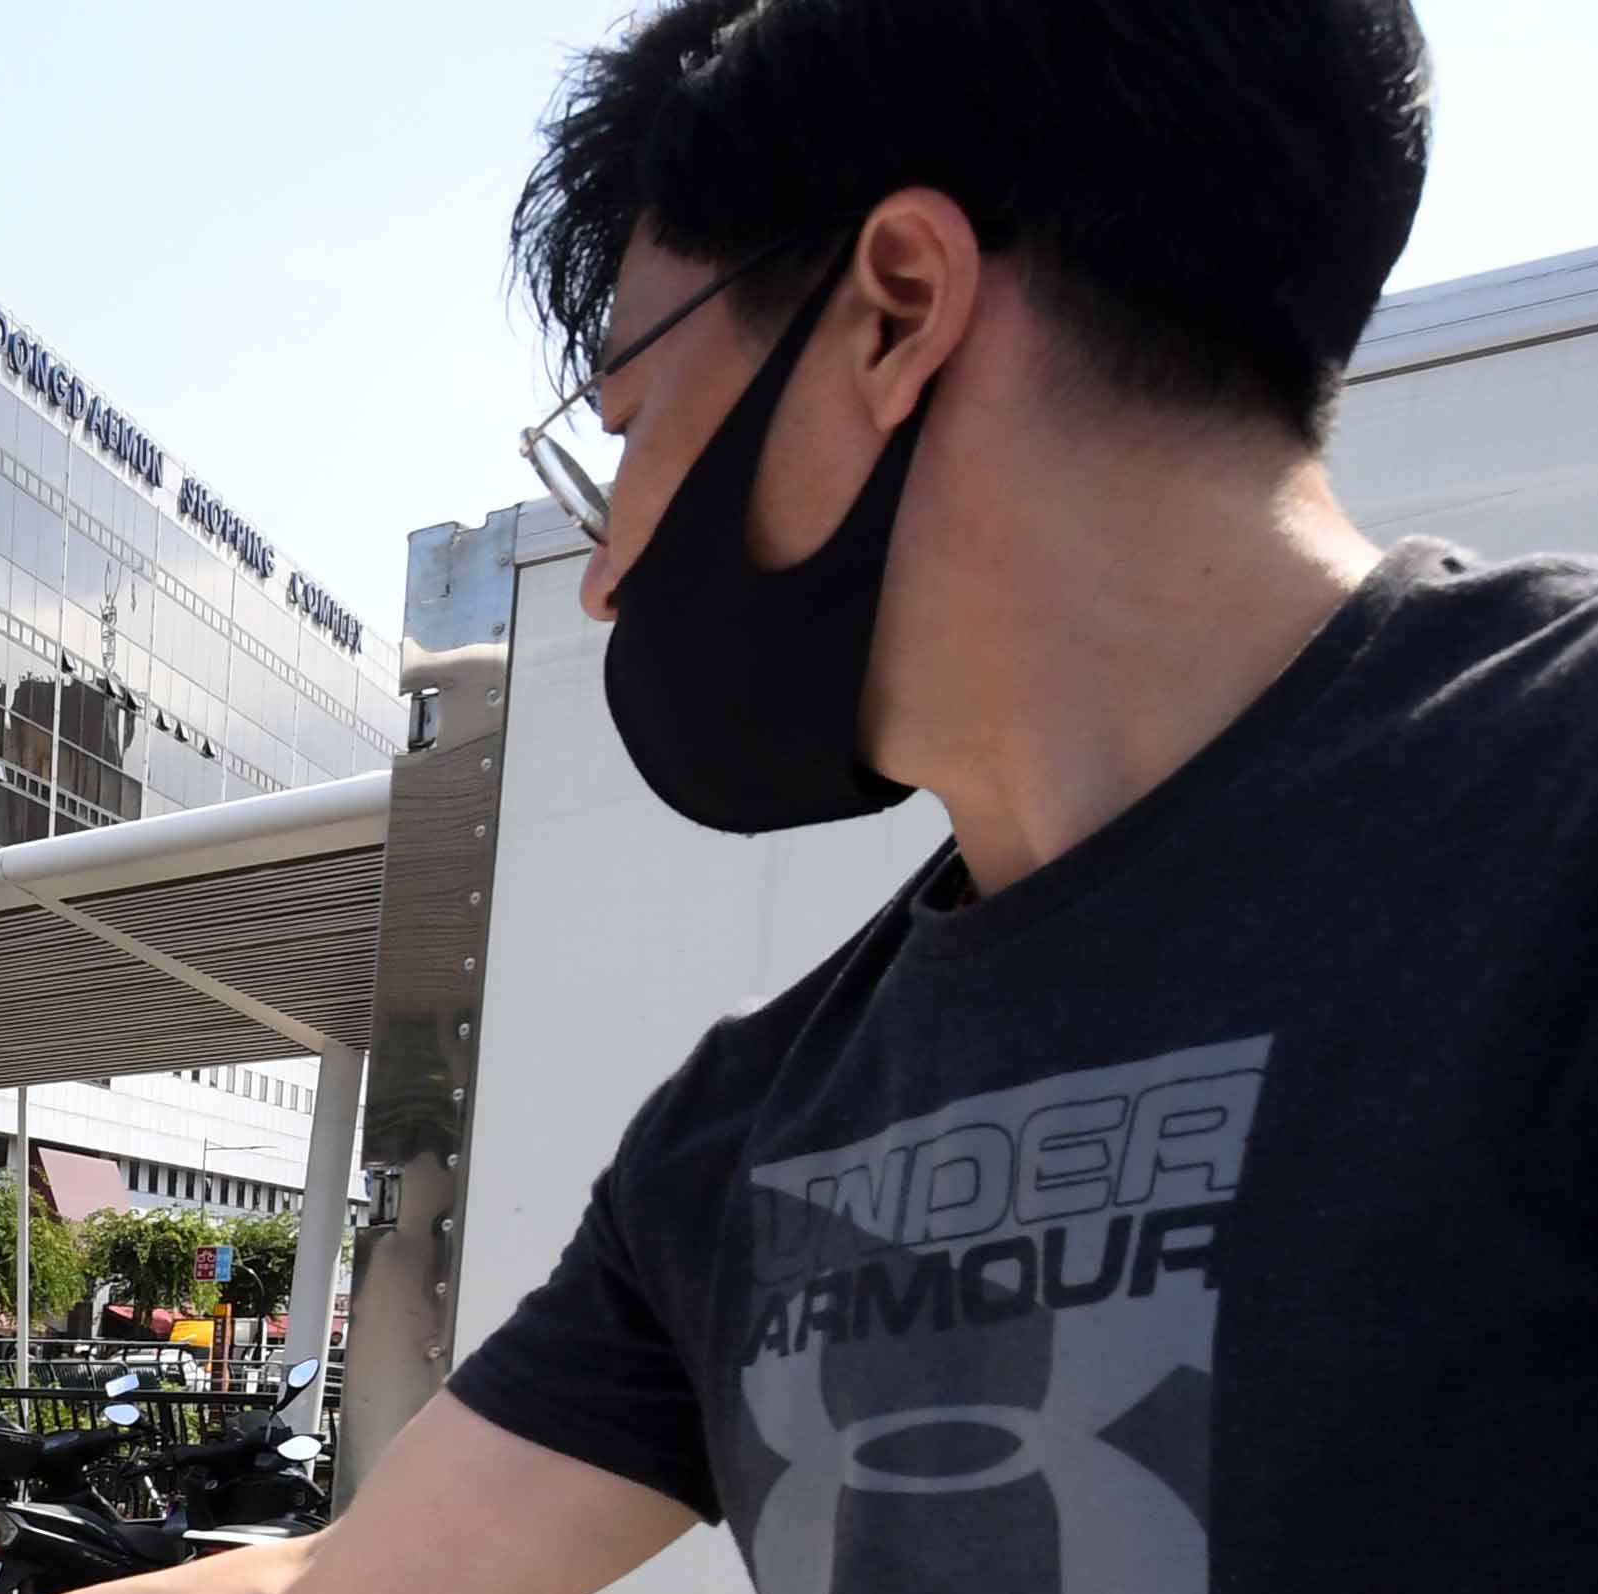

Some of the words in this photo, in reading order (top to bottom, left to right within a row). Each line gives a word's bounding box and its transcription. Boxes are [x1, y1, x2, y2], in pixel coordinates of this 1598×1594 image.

[180, 476, 276, 579] SHOPPING
[288, 571, 364, 655] COMPLEX
[751, 1068, 1267, 1288] UNDER
[739, 1205, 1222, 1367] ARMOUR
